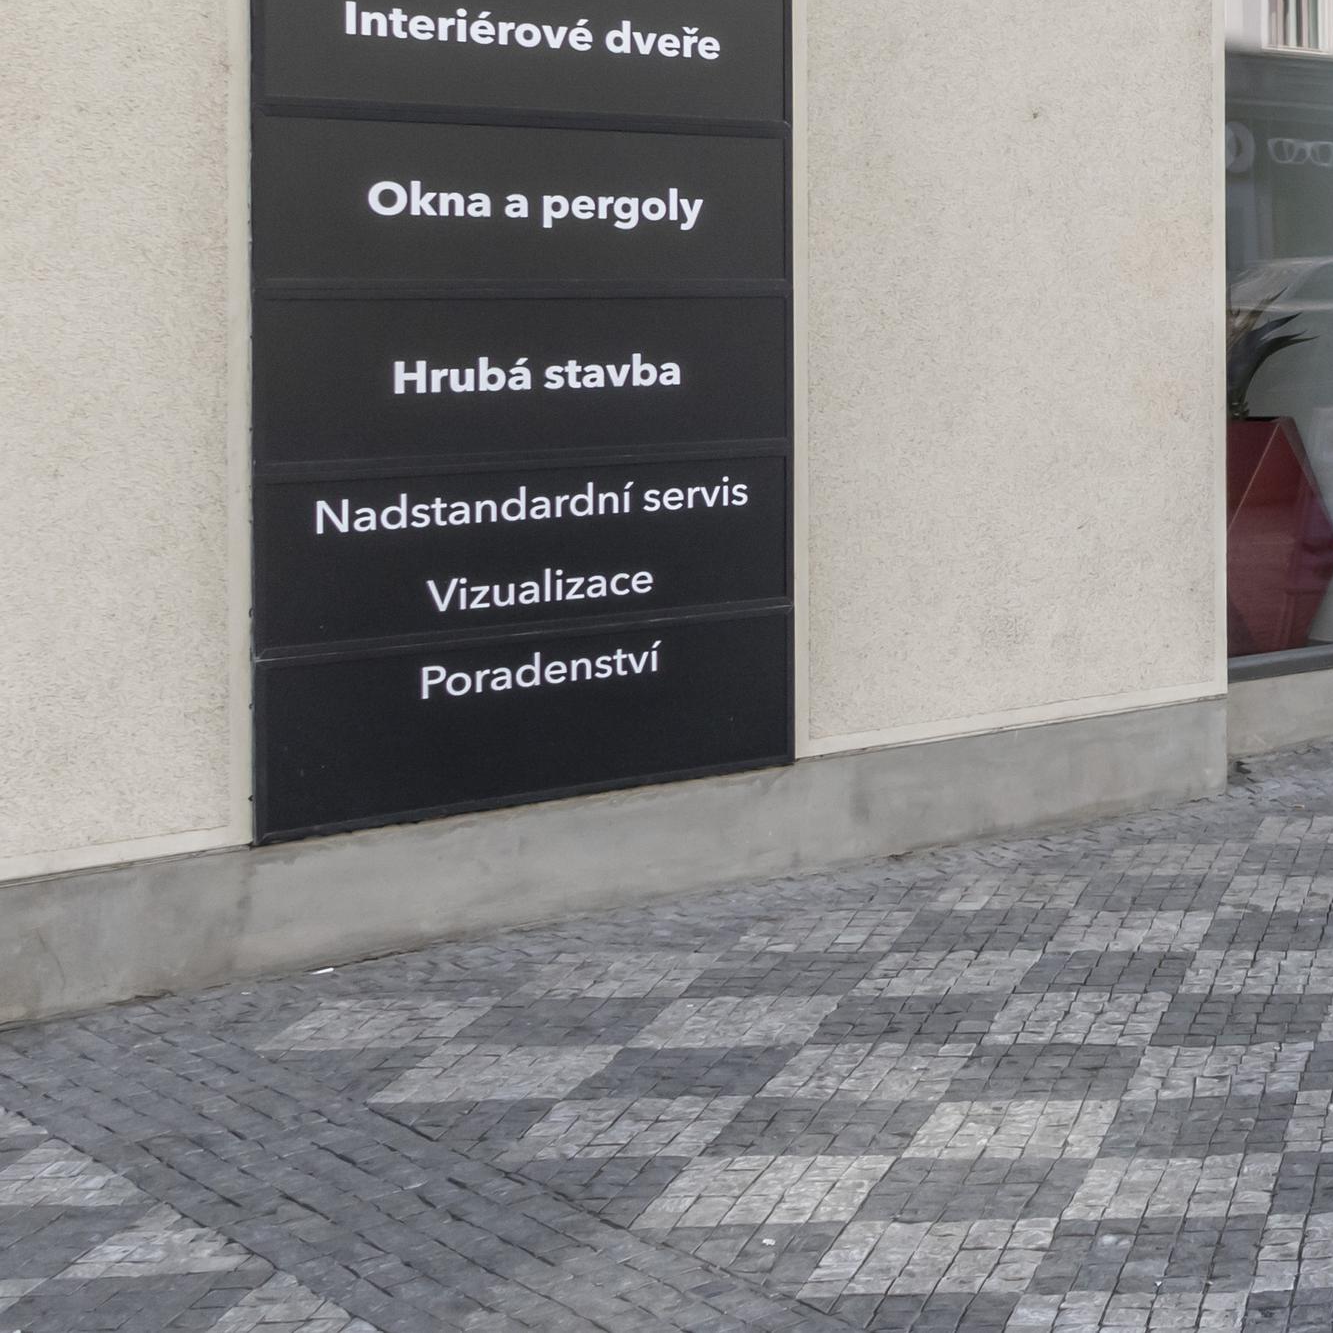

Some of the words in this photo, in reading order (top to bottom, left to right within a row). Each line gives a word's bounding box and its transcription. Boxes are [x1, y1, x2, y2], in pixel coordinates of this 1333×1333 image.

[343, 0, 595, 53] Interiérové
[605, 15, 722, 60] dveře
[367, 180, 493, 220] Okna
[504, 188, 530, 220] a
[542, 185, 704, 231] pergoly
[394, 353, 533, 396] Hrubá
[544, 353, 682, 392] stavba
[314, 482, 632, 535] Nadstandardní
[642, 474, 749, 515] servis
[427, 567, 655, 614] Vizualizace
[420, 640, 663, 702] Poradenství
